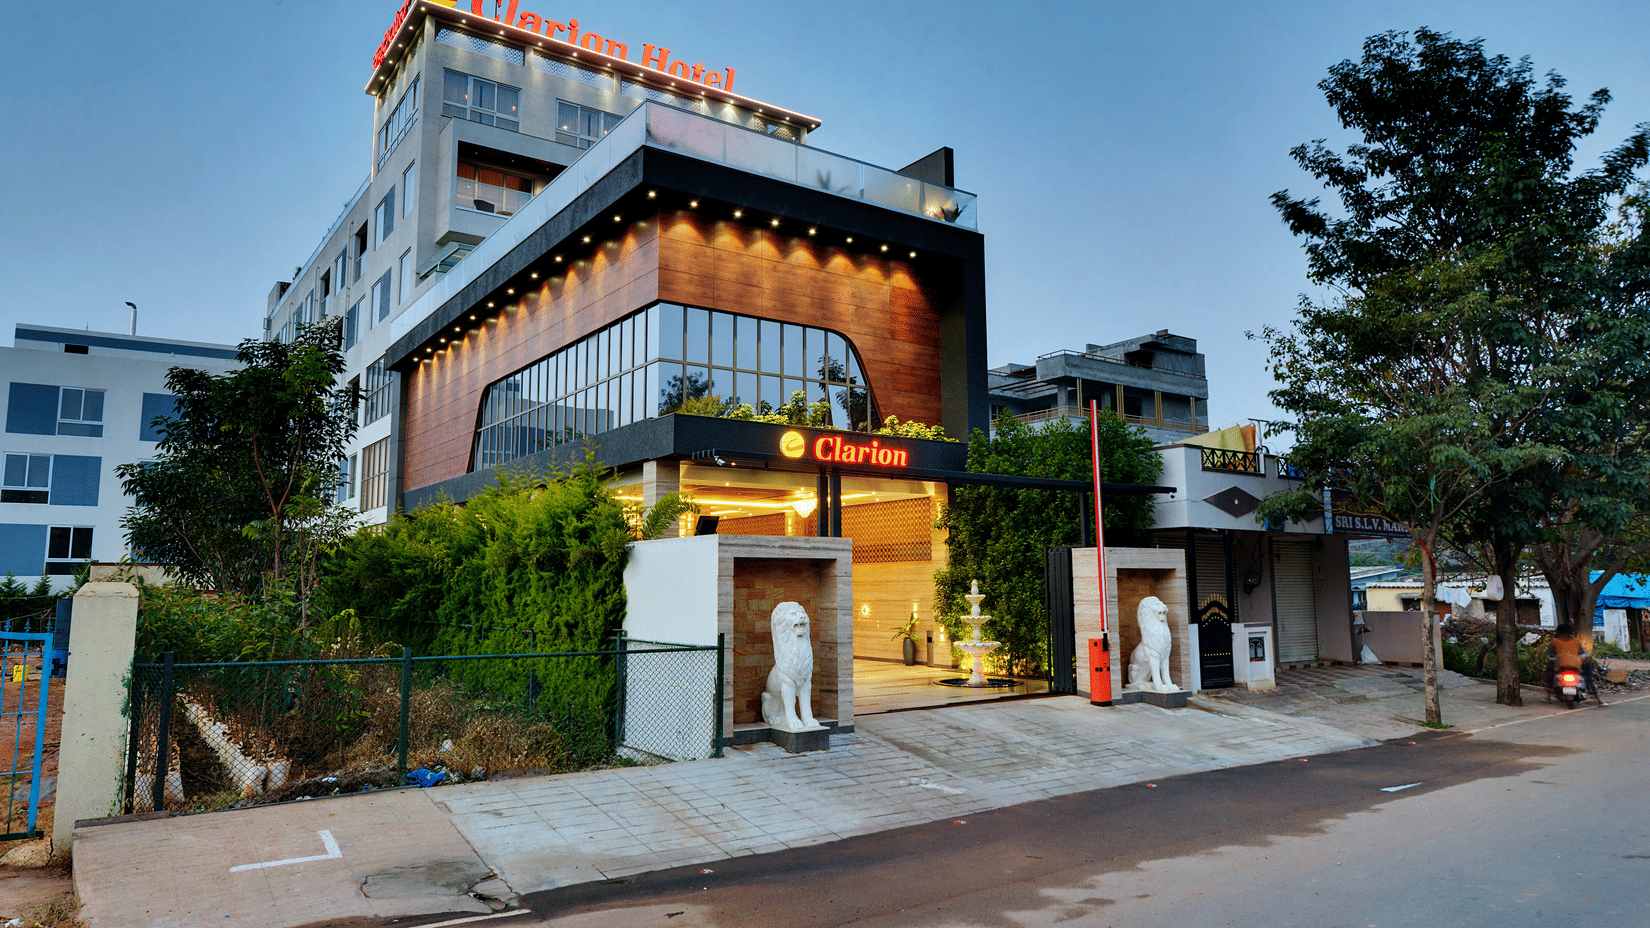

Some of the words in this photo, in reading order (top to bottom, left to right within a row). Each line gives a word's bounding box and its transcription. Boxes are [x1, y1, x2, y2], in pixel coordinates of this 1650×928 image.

[641, 43, 736, 92] Hotel
[814, 436, 907, 466] Clarion
[1335, 515, 1353, 529] SRI
